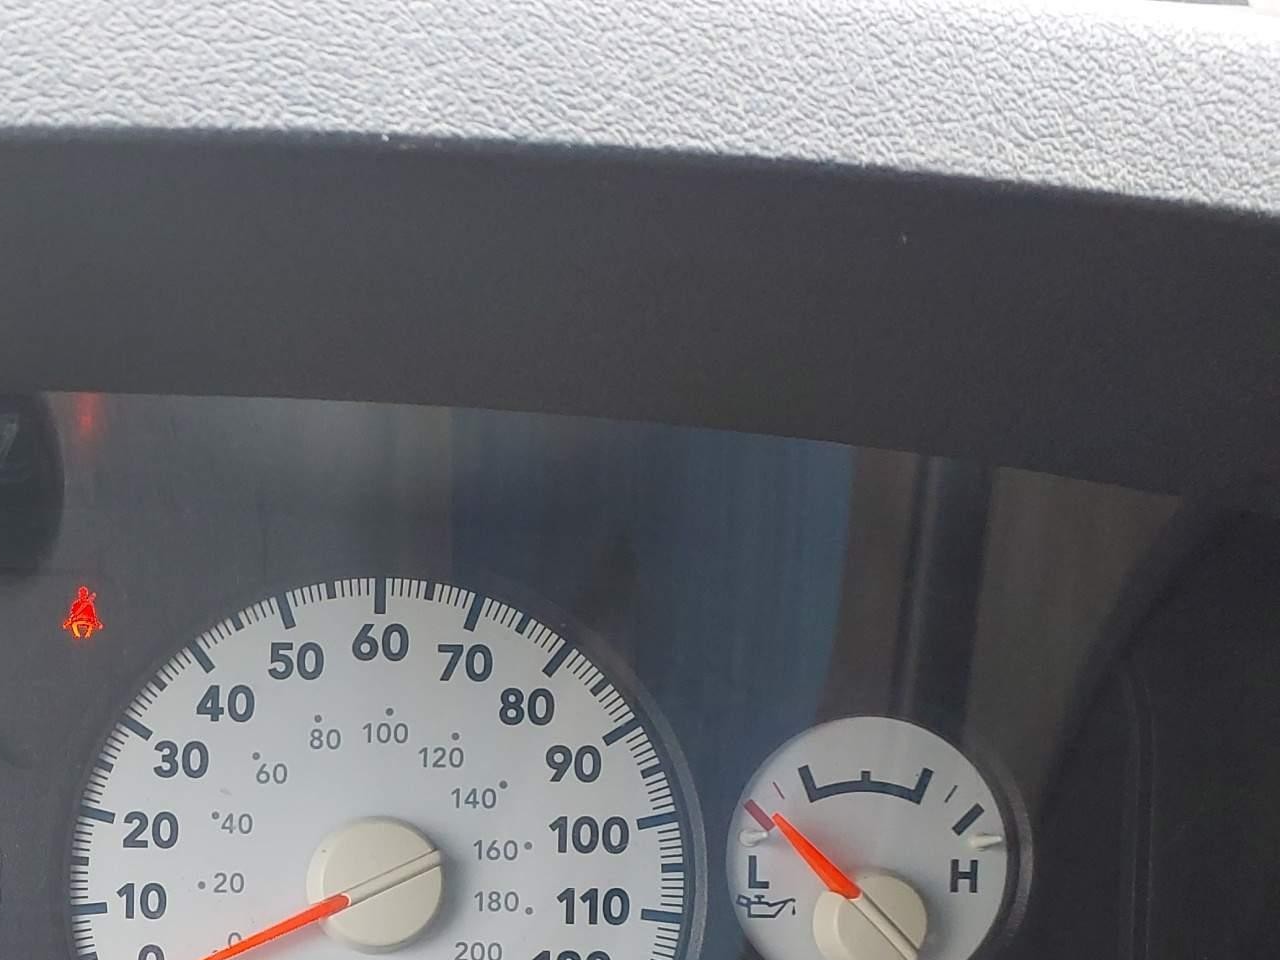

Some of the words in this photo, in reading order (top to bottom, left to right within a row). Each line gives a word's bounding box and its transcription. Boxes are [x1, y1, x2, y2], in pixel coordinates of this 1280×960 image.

[352, 624, 409, 661] 60
[268, 642, 324, 680] 50
[438, 644, 492, 682] 70
[197, 685, 254, 722] 40
[499, 688, 554, 725] 80
[310, 729, 340, 749] 80
[364, 723, 408, 743] 100
[154, 741, 208, 778] 30
[256, 764, 287, 784] 60
[420, 747, 463, 768] 120
[546, 745, 601, 783] 90
[452, 788, 496, 809] 140
[123, 811, 178, 849] 20
[221, 813, 252, 834] 40
[549, 816, 629, 854] 100
[474, 840, 517, 860] 160
[214, 873, 244, 893] 20
[748, 856, 769, 889] L
[950, 859, 978, 893] H
[117, 883, 166, 919] 10
[475, 891, 519, 911] 180
[557, 888, 629, 925] 110
